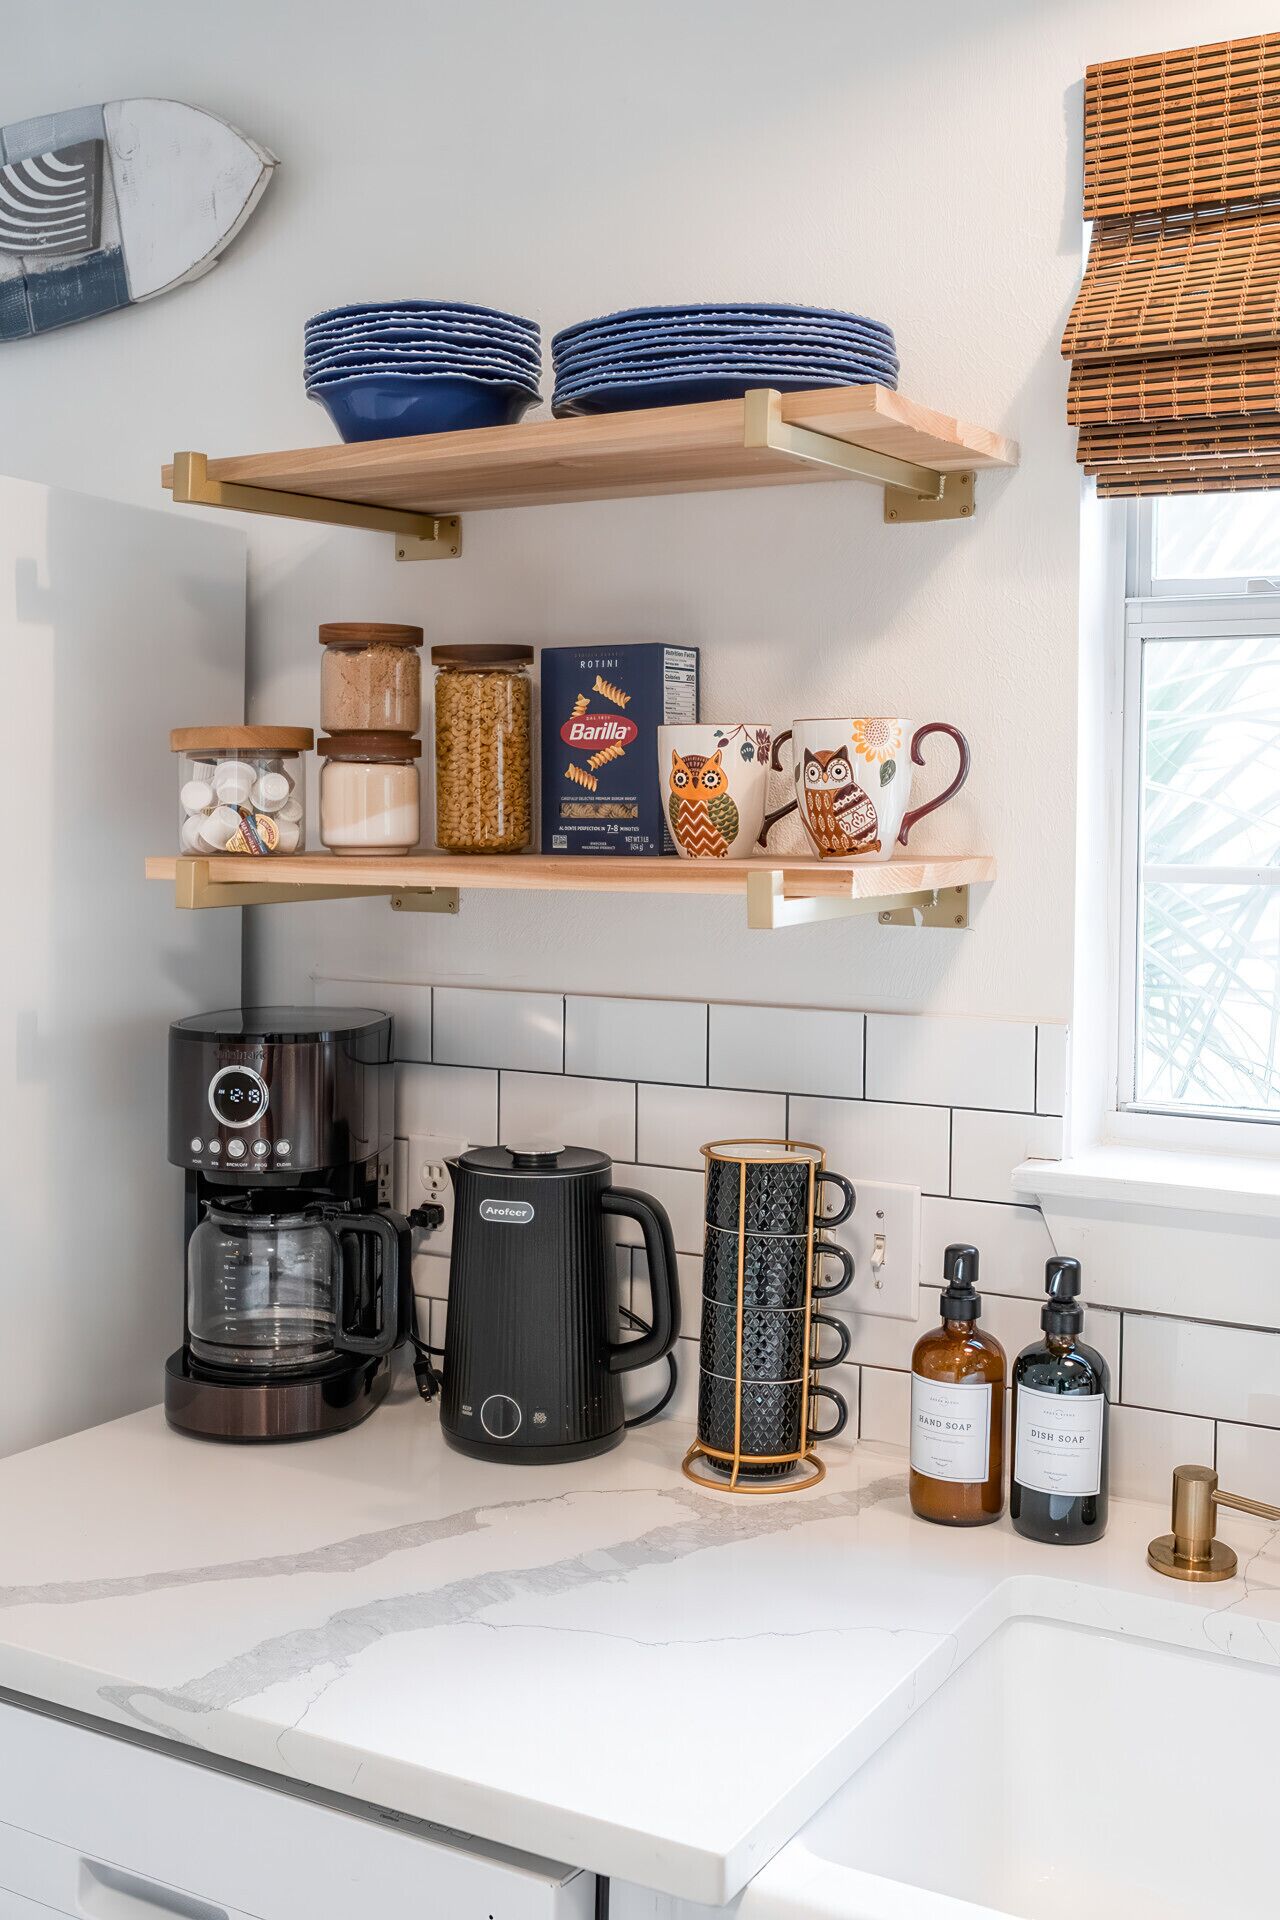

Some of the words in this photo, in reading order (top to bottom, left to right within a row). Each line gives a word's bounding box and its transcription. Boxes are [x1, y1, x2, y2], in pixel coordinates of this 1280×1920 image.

[580, 659, 618, 669] ROTINI
[569, 722, 627, 740] Barilla
[486, 1206, 527, 1217] Arofeer
[919, 1415, 942, 1428] HAND
[946, 1422, 972, 1431] SOAP
[1031, 1430, 1054, 1441] DISH
